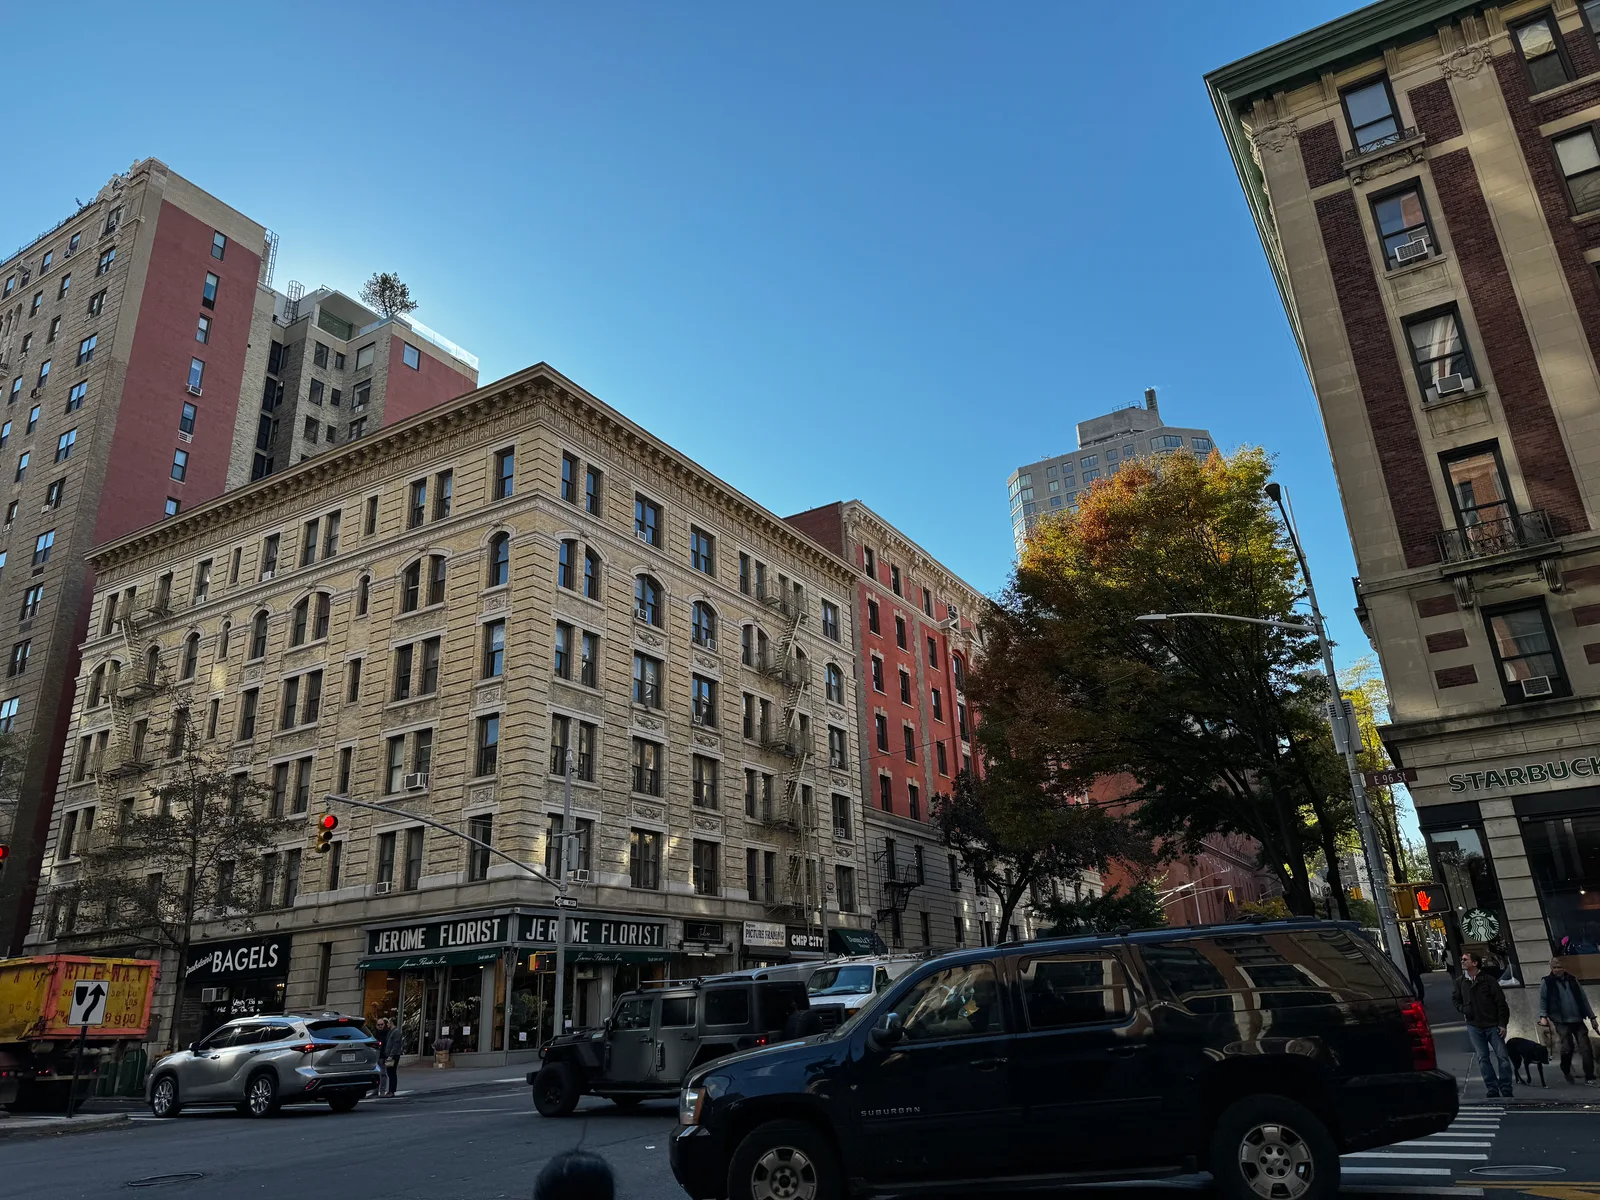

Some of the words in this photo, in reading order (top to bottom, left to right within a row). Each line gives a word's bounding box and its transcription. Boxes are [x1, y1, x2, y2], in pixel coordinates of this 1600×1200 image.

[1374, 775, 1380, 785] E
[1382, 773, 1394, 784] 96
[1397, 771, 1407, 782] St
[375, 927, 426, 953] JEROME
[440, 919, 500, 946] FLORIST
[526, 918, 590, 943] JERME
[601, 922, 660, 945] FLORIST
[791, 934, 807, 946] CHIP
[808, 935, 824, 947] CITY
[212, 944, 279, 973] BAGELS
[861, 1106, 920, 1117] SUBURBAN
